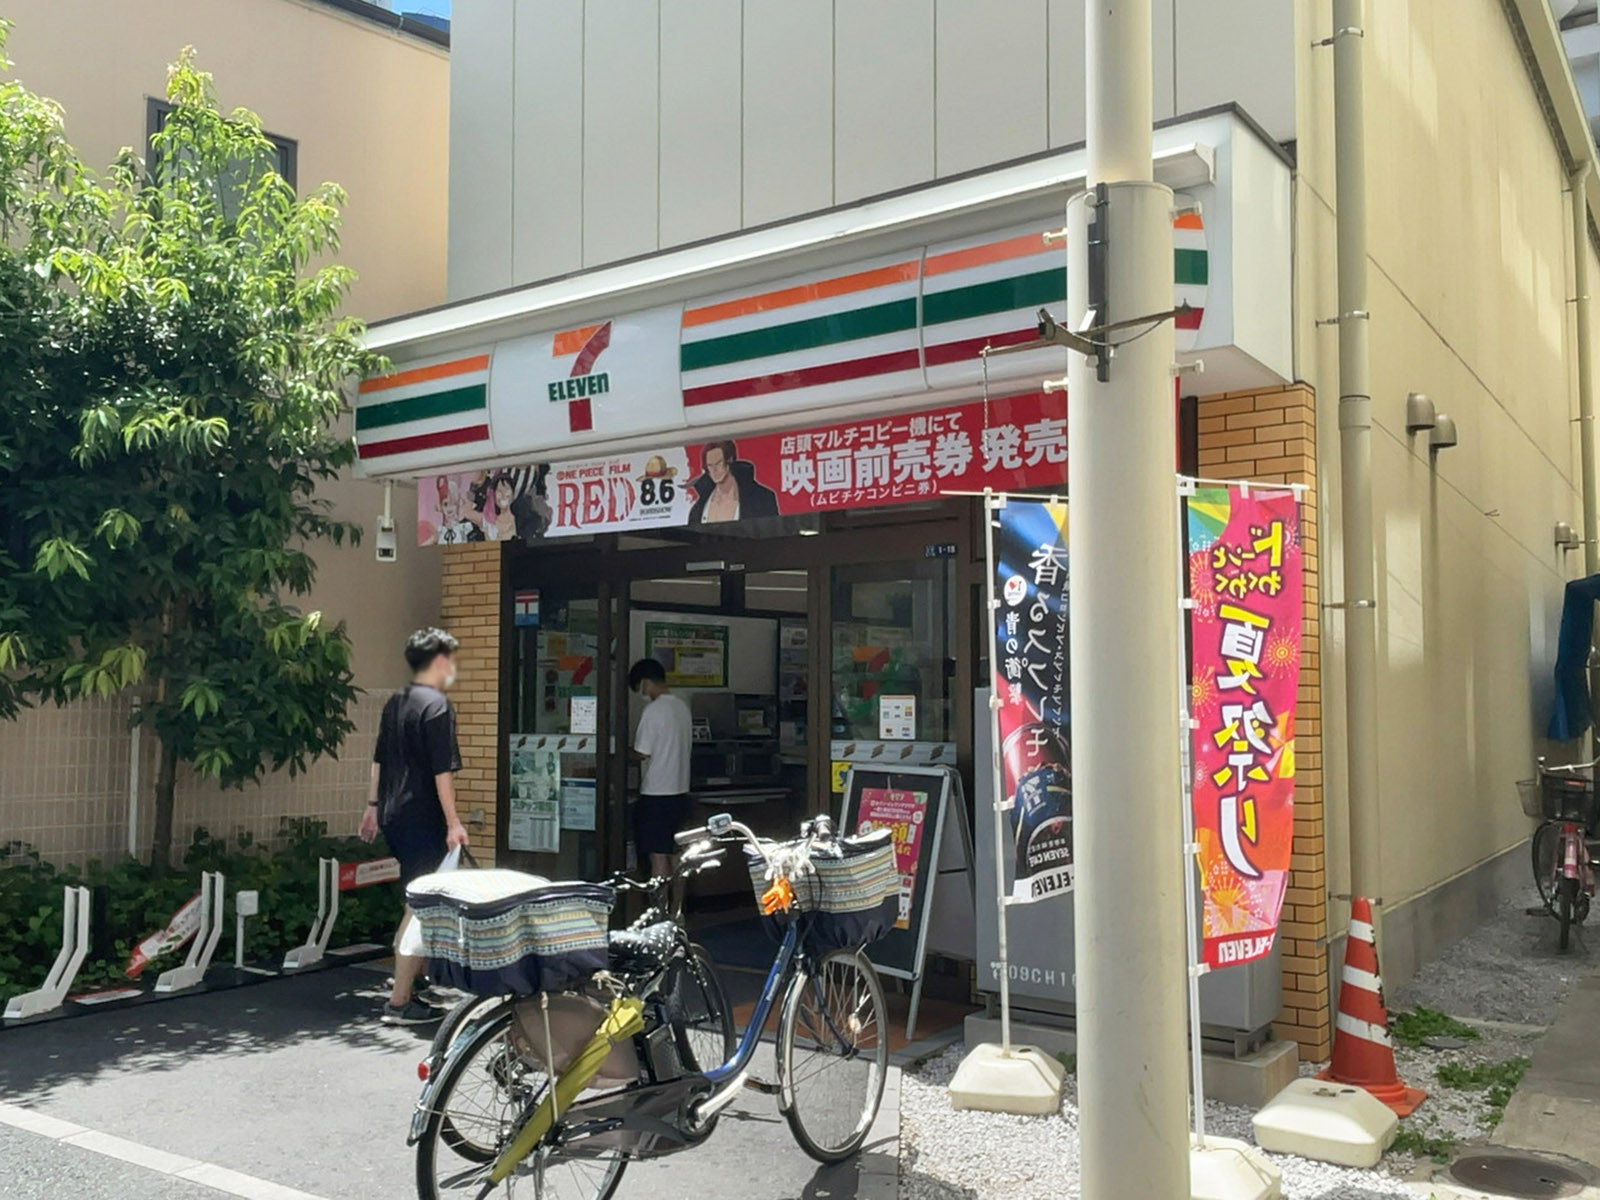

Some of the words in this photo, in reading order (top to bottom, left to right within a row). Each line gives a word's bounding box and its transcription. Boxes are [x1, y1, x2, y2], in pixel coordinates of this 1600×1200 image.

[552, 320, 613, 433] 7
[780, 412, 963, 456] 店頭マルチコピー機にて
[556, 469, 577, 481] ONE
[578, 466, 605, 479] PIECE
[609, 463, 632, 475] FILM
[780, 431, 973, 496] 映画前売券
[640, 478, 675, 506] 8.6
